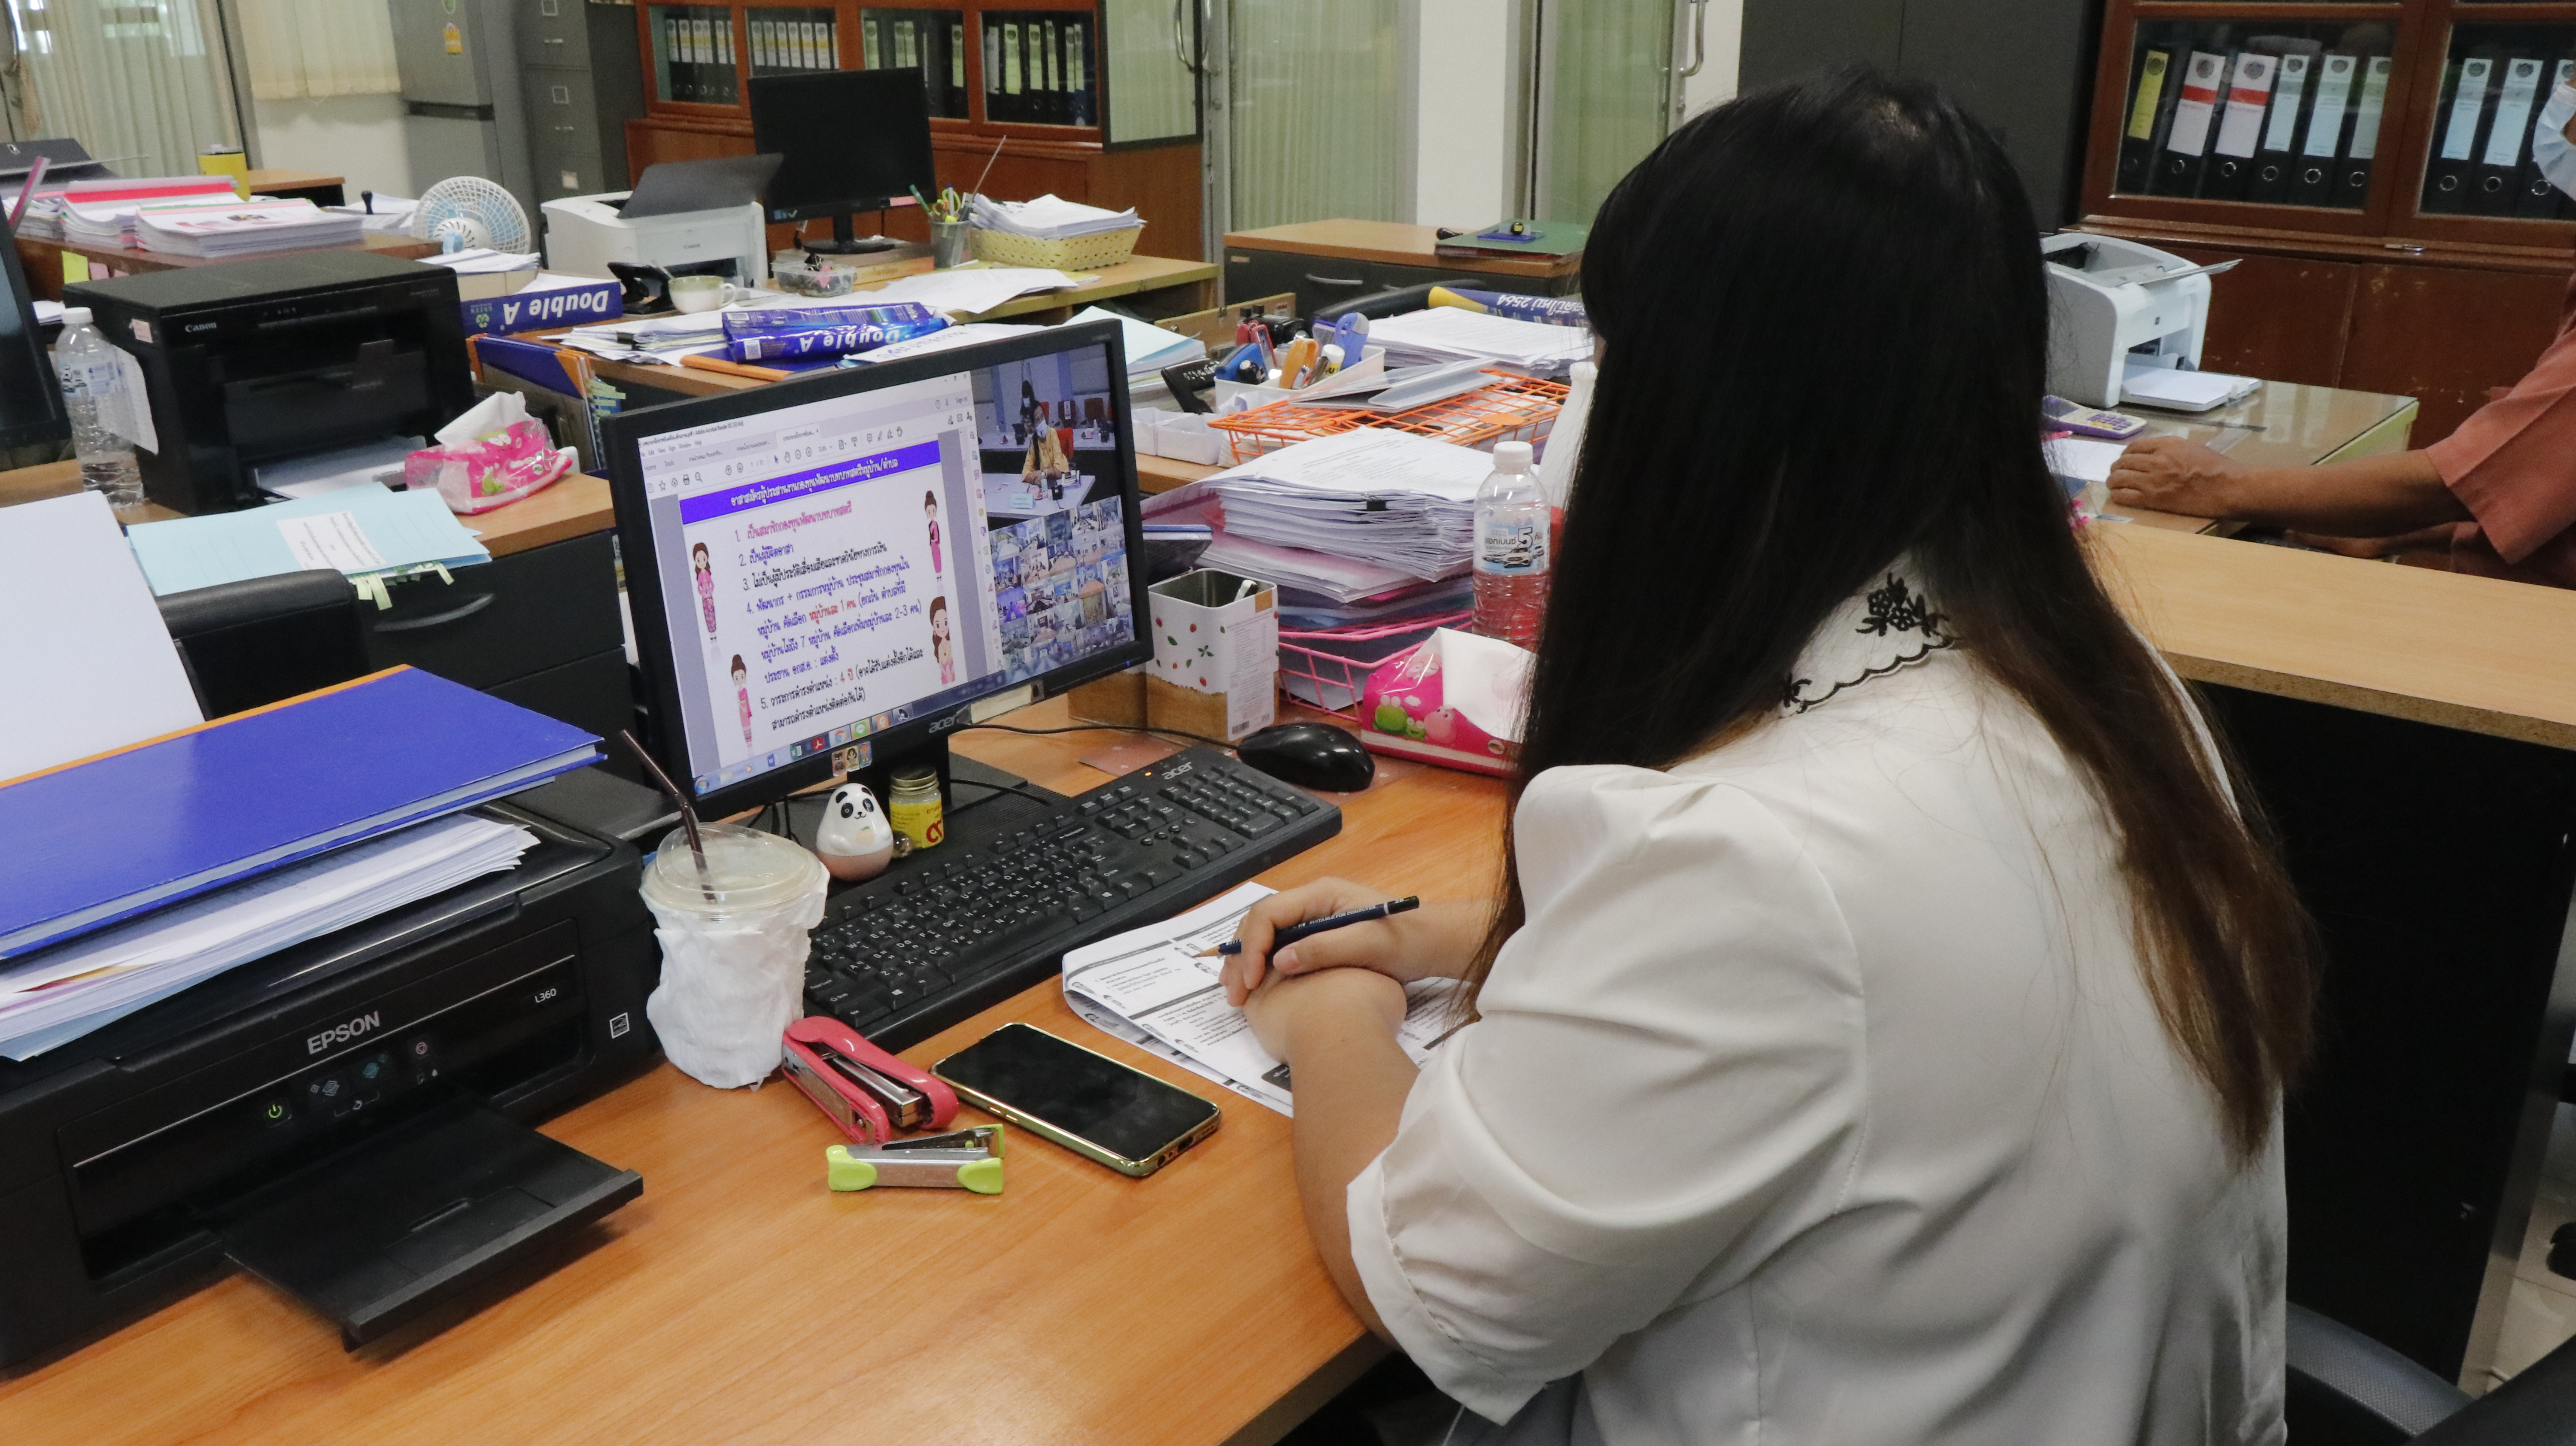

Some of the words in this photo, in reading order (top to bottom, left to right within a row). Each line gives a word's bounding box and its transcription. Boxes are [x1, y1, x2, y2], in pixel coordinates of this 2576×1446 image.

[529, 290, 609, 320] Double
[1496, 295, 1533, 308] 2564
[502, 301, 521, 325] A
[185, 322, 217, 332] Canon
[799, 336, 814, 352] A
[823, 328, 900, 349] Double
[1518, 526, 1533, 548] 5
[738, 553, 747, 567] 2.
[742, 577, 750, 591] 3.
[746, 602, 753, 614] 4.
[756, 595, 784, 611] พัฒนากร
[796, 575, 844, 600] กรรมการหมู่บ้าน
[757, 618, 781, 640] หมู่บ้าน
[783, 611, 807, 628] คัดเลือก
[808, 603, 838, 625] หมู่บ้านละ
[846, 599, 857, 609] คน
[800, 635, 805, 648] 7
[808, 628, 831, 649] หมู่บ้าน
[894, 604, 908, 619] 2-3
[909, 599, 921, 614] คน)
[764, 668, 790, 683] ประธาน
[760, 697, 768, 709] 5.
[840, 671, 845, 683] 4
[847, 667, 854, 680] ปี
[928, 716, 956, 734] acer
[1161, 761, 1193, 781] acer
[1309, 915, 1335, 924] SUITABLE
[534, 987, 558, 1004] L360
[307, 1010, 381, 1055] EPSON
